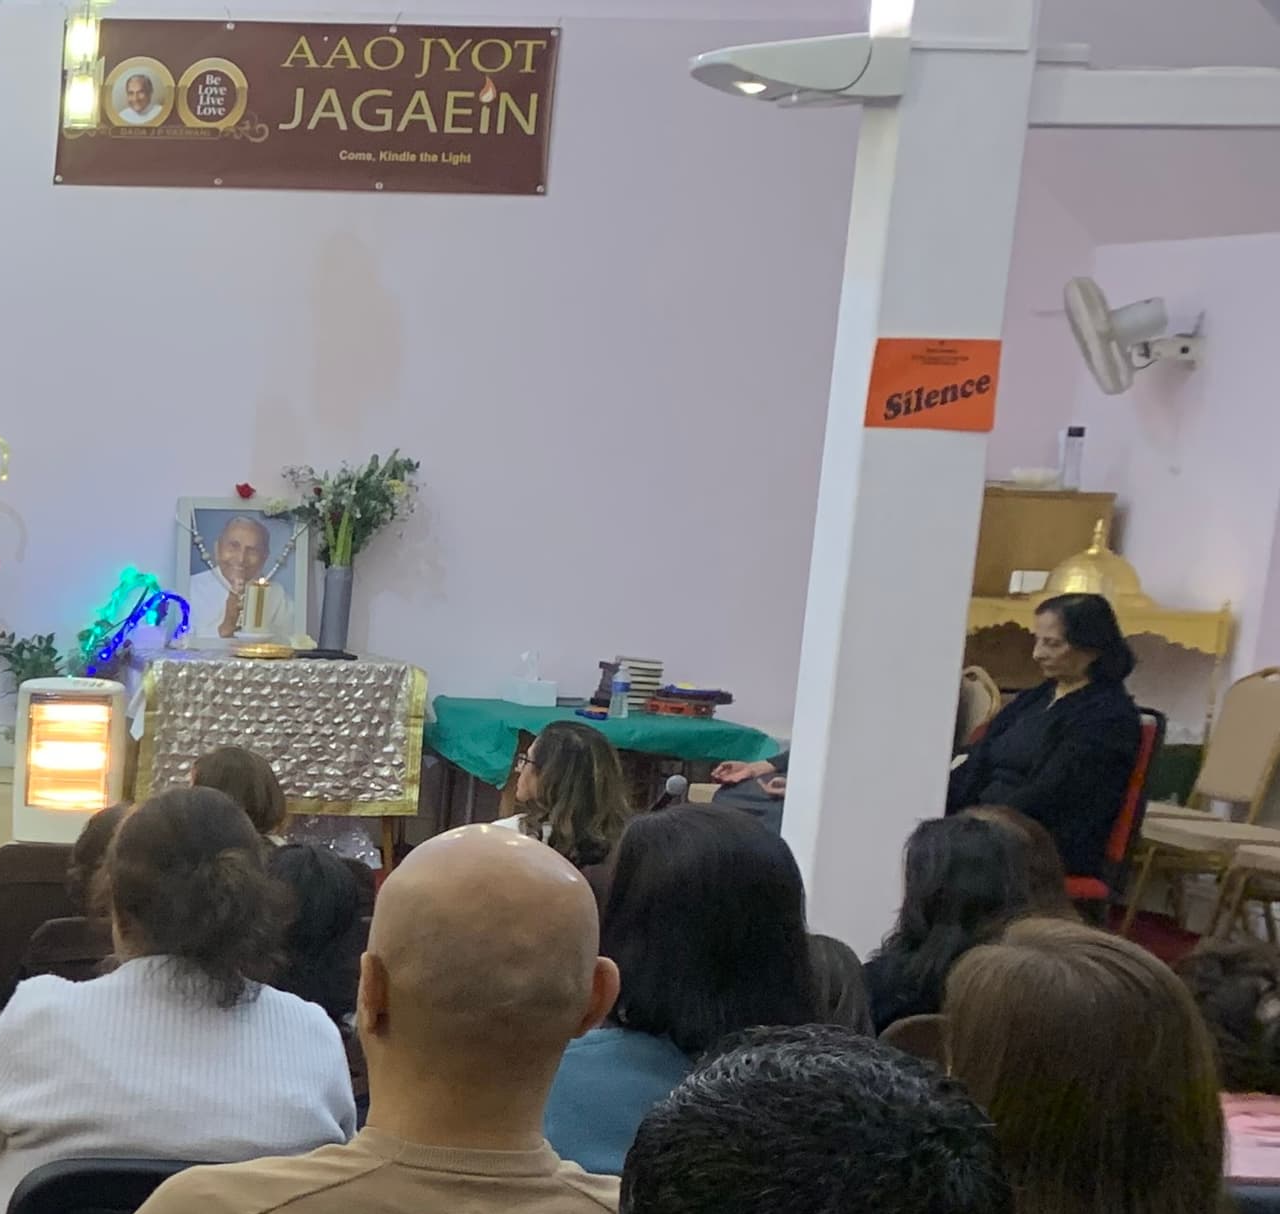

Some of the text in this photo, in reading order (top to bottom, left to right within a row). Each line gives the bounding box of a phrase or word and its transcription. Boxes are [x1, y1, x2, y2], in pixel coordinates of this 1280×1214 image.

[280, 35, 547, 78] AAO JYOT
[206, 74, 222, 85] Be
[198, 84, 227, 96] Love
[200, 95, 225, 106] Live
[196, 105, 226, 116] Love
[379, 151, 417, 162] Kindle
[420, 151, 439, 163] the
[442, 151, 472, 166] Light
[883, 374, 992, 421] Silence
